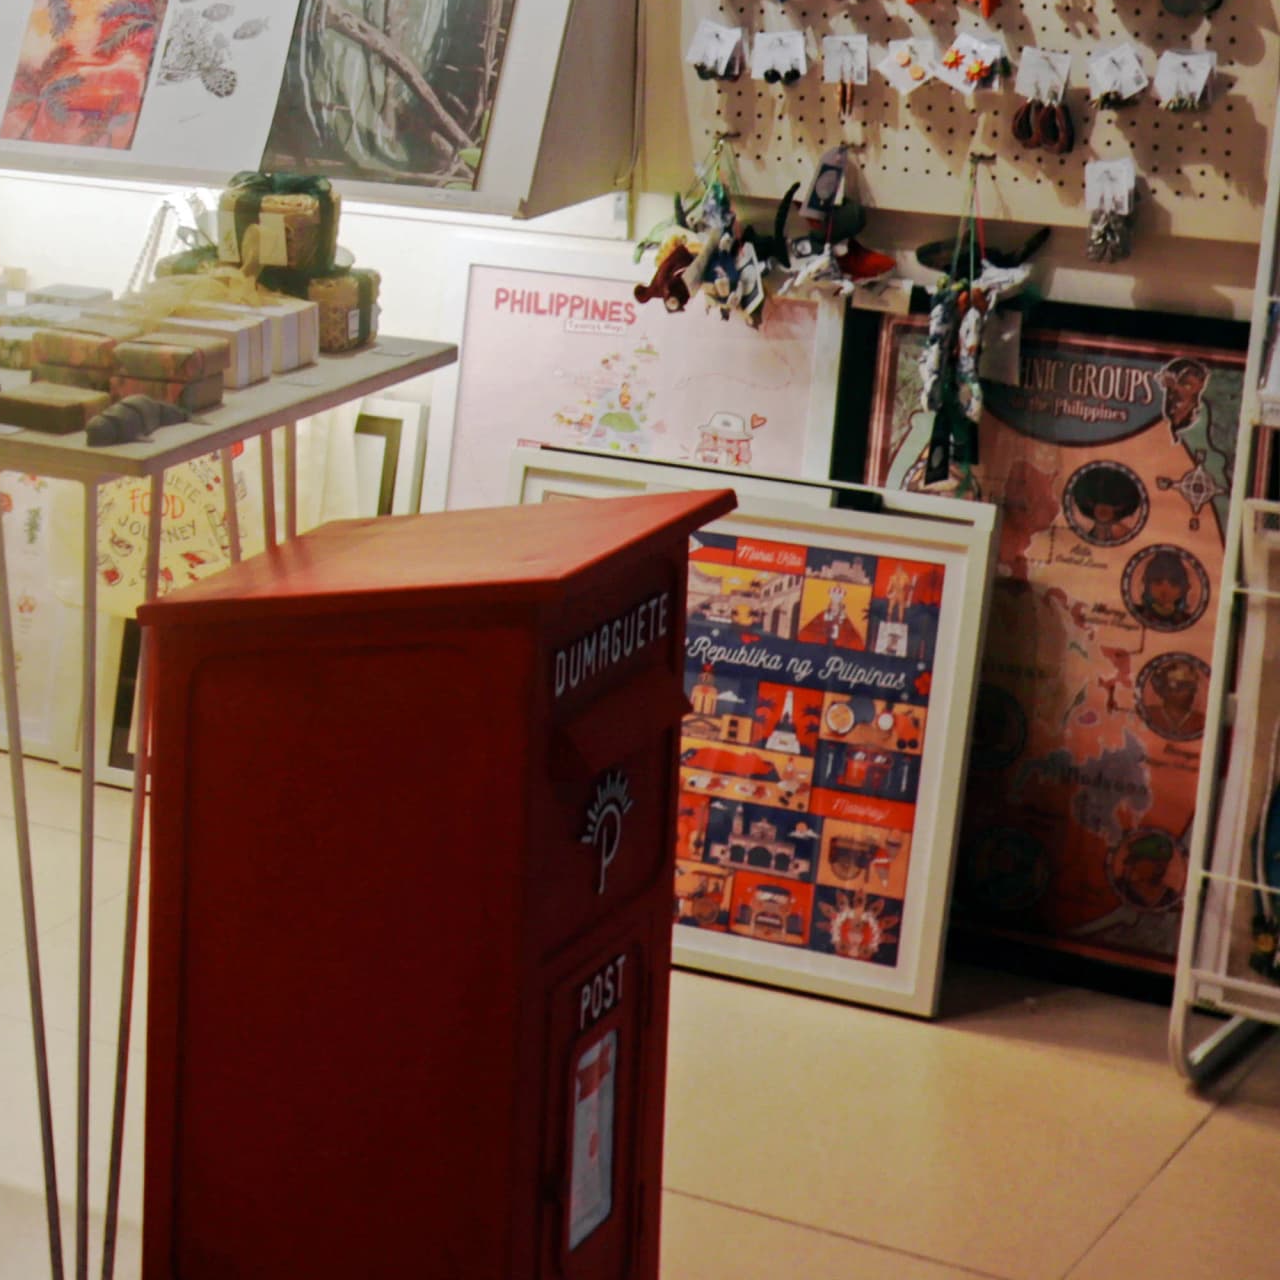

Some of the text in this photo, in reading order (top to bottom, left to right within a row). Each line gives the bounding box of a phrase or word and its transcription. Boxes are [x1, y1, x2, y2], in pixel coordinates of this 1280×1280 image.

[494, 286, 638, 326] PHILIPPINES
[1068, 362, 1154, 405] GROUPS
[1054, 398, 1128, 423] Philippines
[129, 485, 186, 520] FOOD
[118, 515, 197, 544] JONEY
[554, 591, 671, 698] DUMAGUETE
[687, 634, 908, 691] Republika ng Pilipinas
[579, 953, 627, 1031] POST
